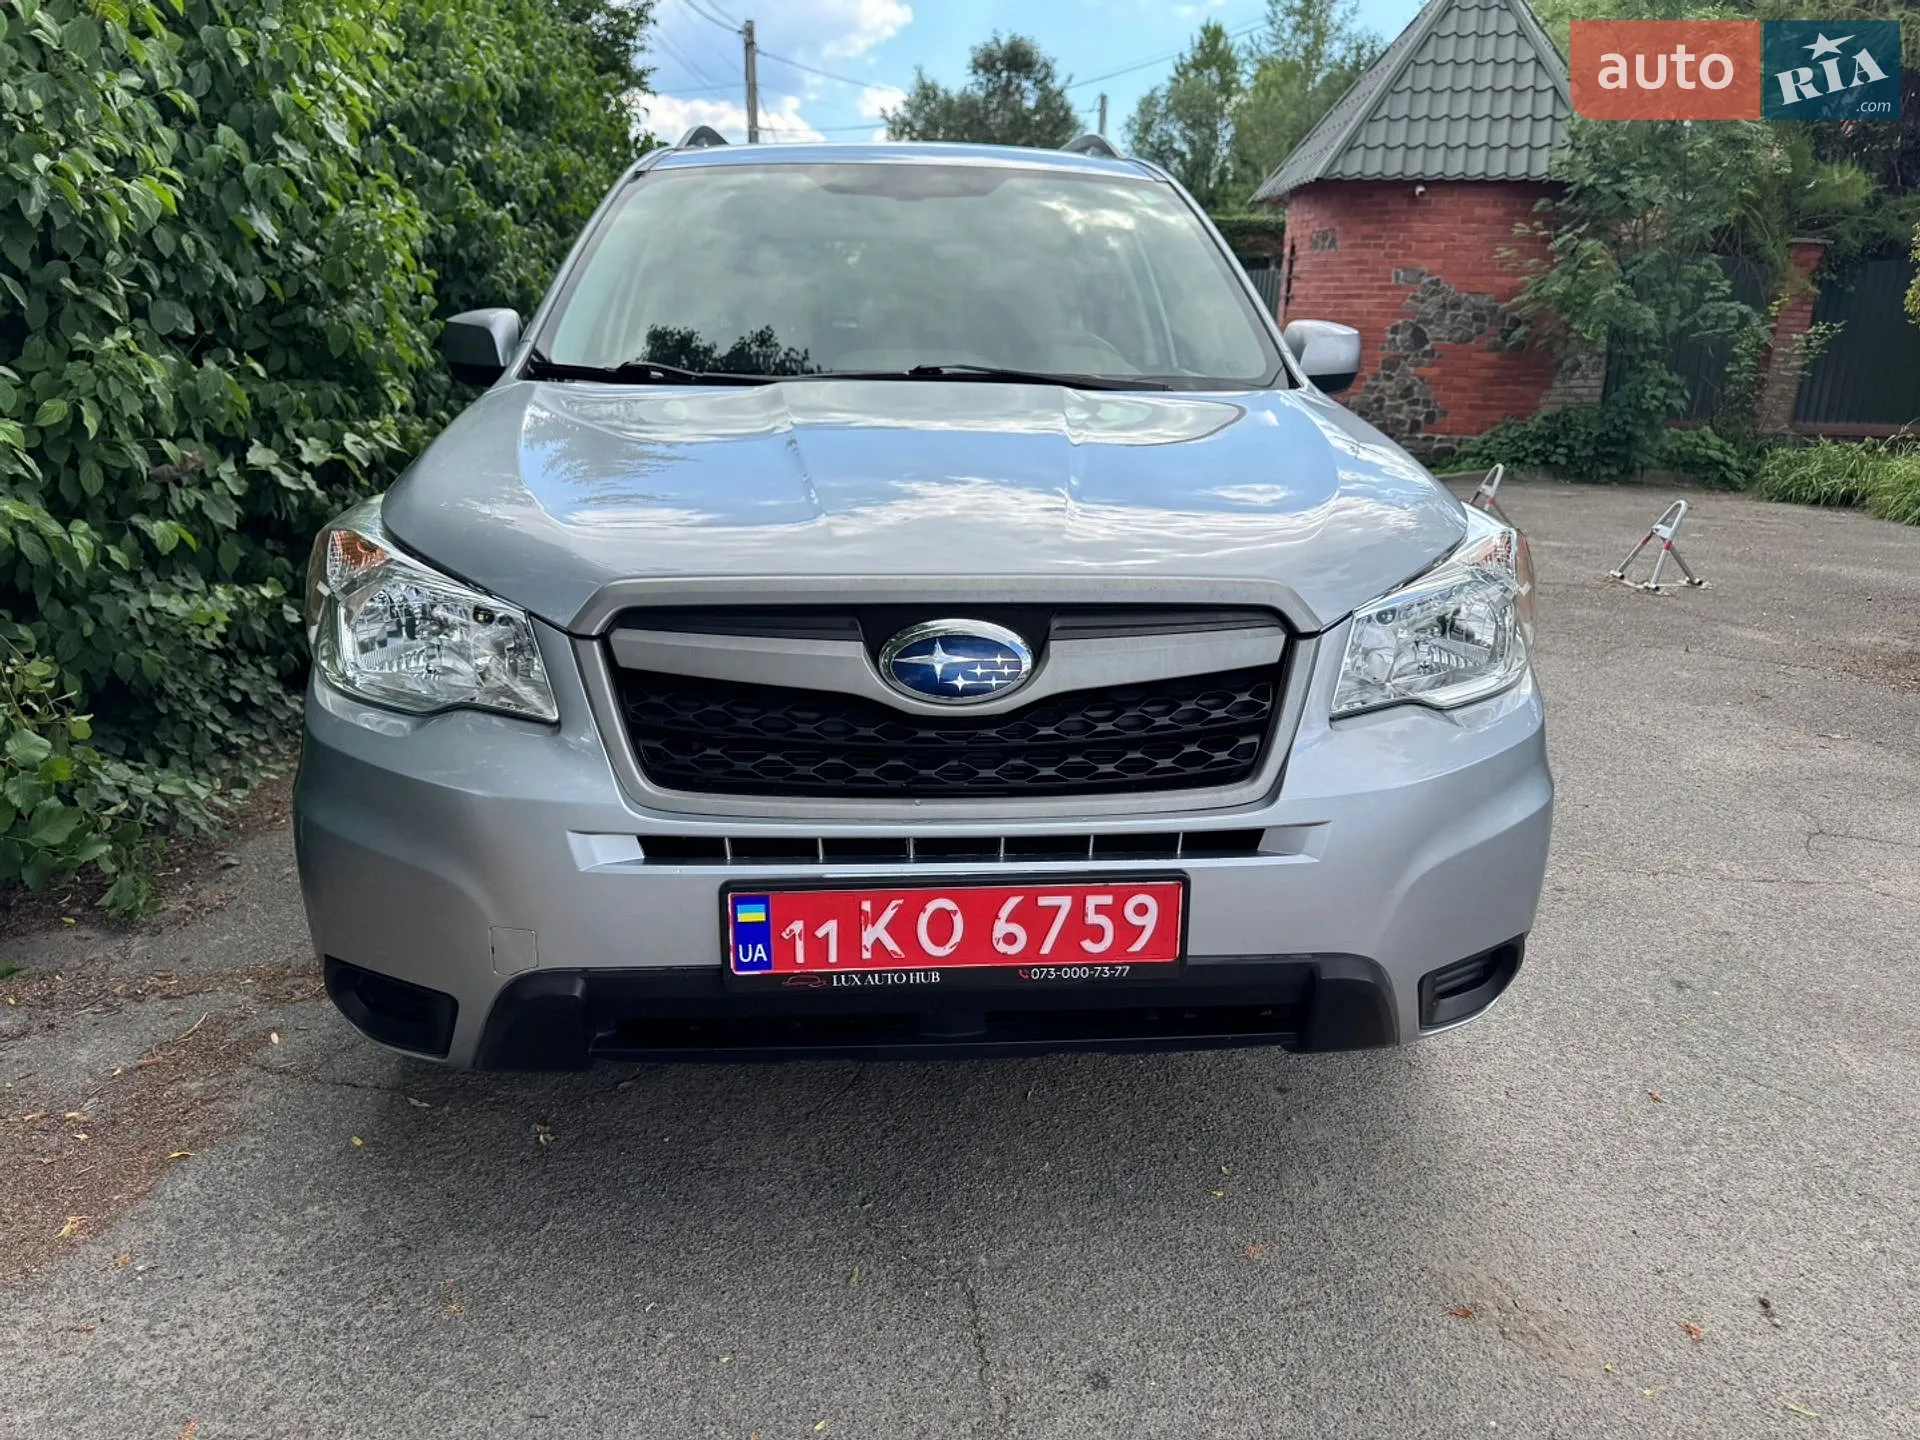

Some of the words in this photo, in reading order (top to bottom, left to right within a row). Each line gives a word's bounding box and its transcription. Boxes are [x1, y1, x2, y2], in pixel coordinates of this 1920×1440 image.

[780, 920, 840, 963] 11
[992, 894, 1160, 955] 6759
[738, 944, 768, 963] UA
[832, 975, 862, 986] LUX
[865, 973, 907, 986] AUTO
[909, 972, 941, 985] HUB
[1031, 966, 1130, 979] 073-000-73-77
